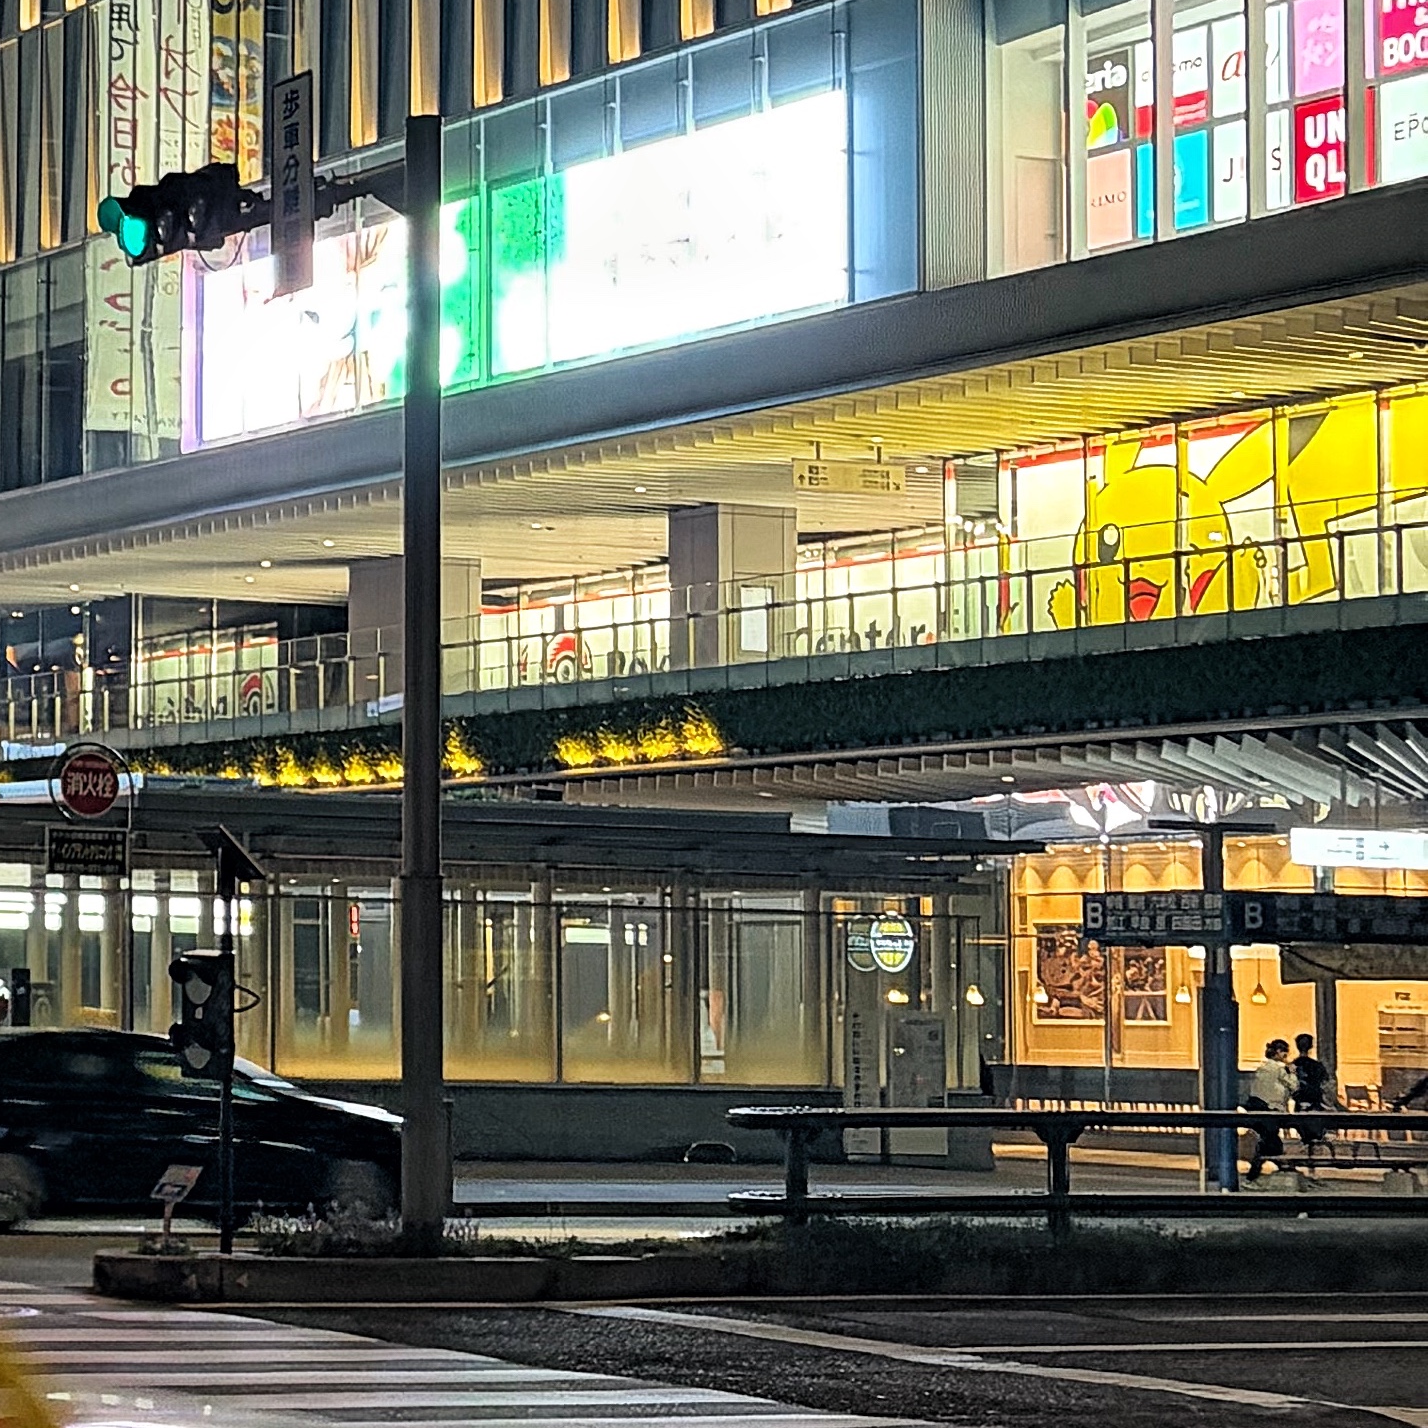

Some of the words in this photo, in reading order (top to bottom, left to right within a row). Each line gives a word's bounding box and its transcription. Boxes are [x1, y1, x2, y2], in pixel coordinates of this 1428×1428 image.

[66, 771, 115, 799] 消火栓
[1086, 902, 1103, 929] B
[1245, 902, 1263, 929] B
